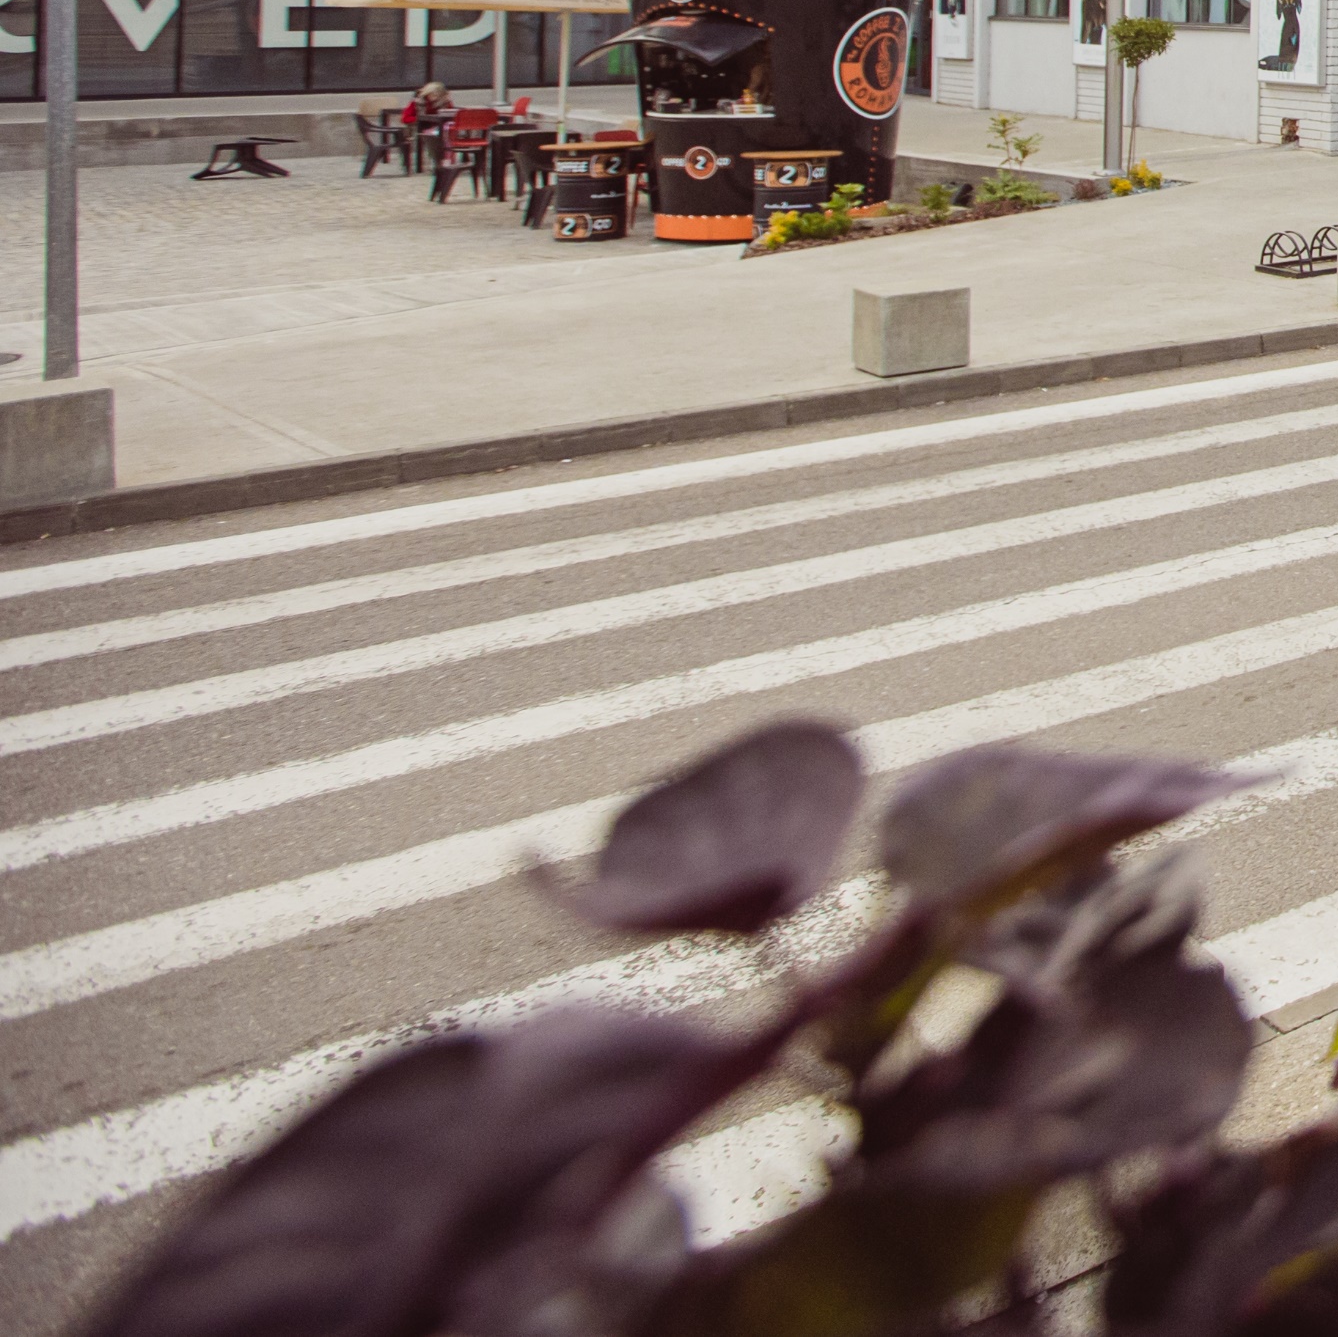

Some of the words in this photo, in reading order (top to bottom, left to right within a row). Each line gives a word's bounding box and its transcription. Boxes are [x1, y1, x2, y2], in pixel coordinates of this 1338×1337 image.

[694, 155, 707, 171] 2
[779, 165, 797, 185] 2
[561, 217, 576, 236] 2
